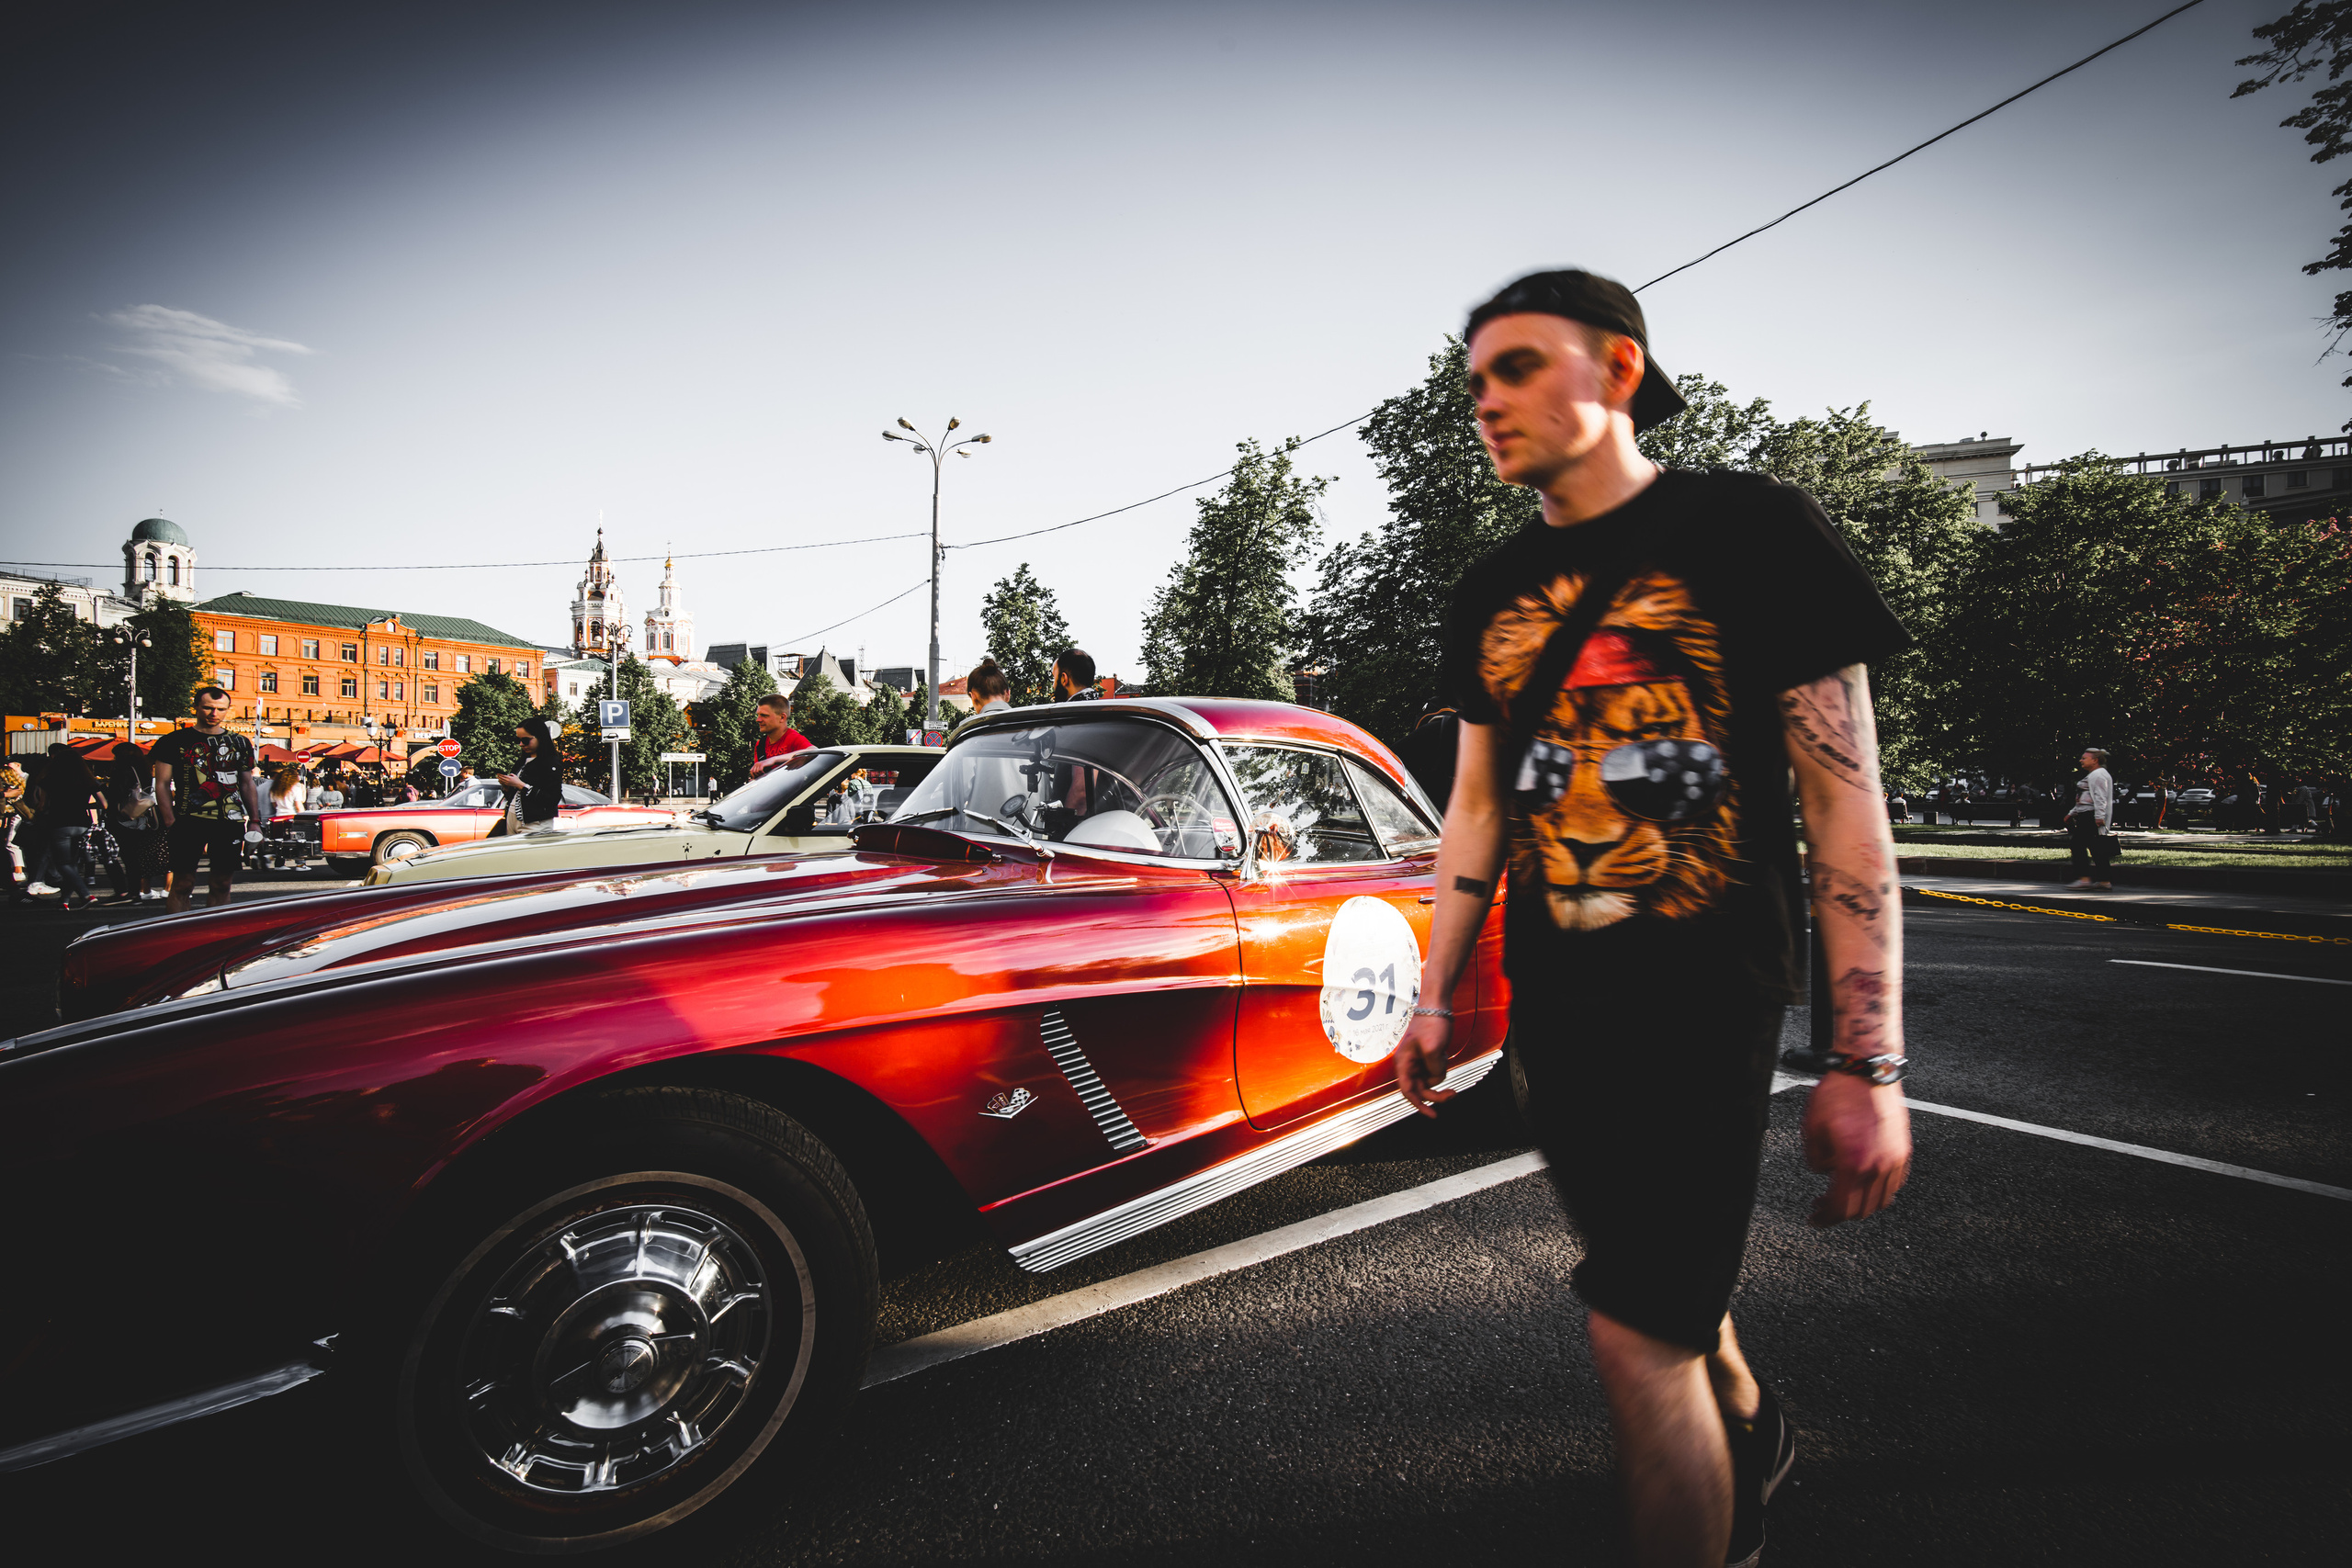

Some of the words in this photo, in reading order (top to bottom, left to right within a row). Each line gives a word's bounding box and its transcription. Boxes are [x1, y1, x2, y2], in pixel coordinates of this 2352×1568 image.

[607, 704, 623, 723] P
[1347, 963, 1396, 1021] 31
[1372, 1023, 1385, 1033] 2021
